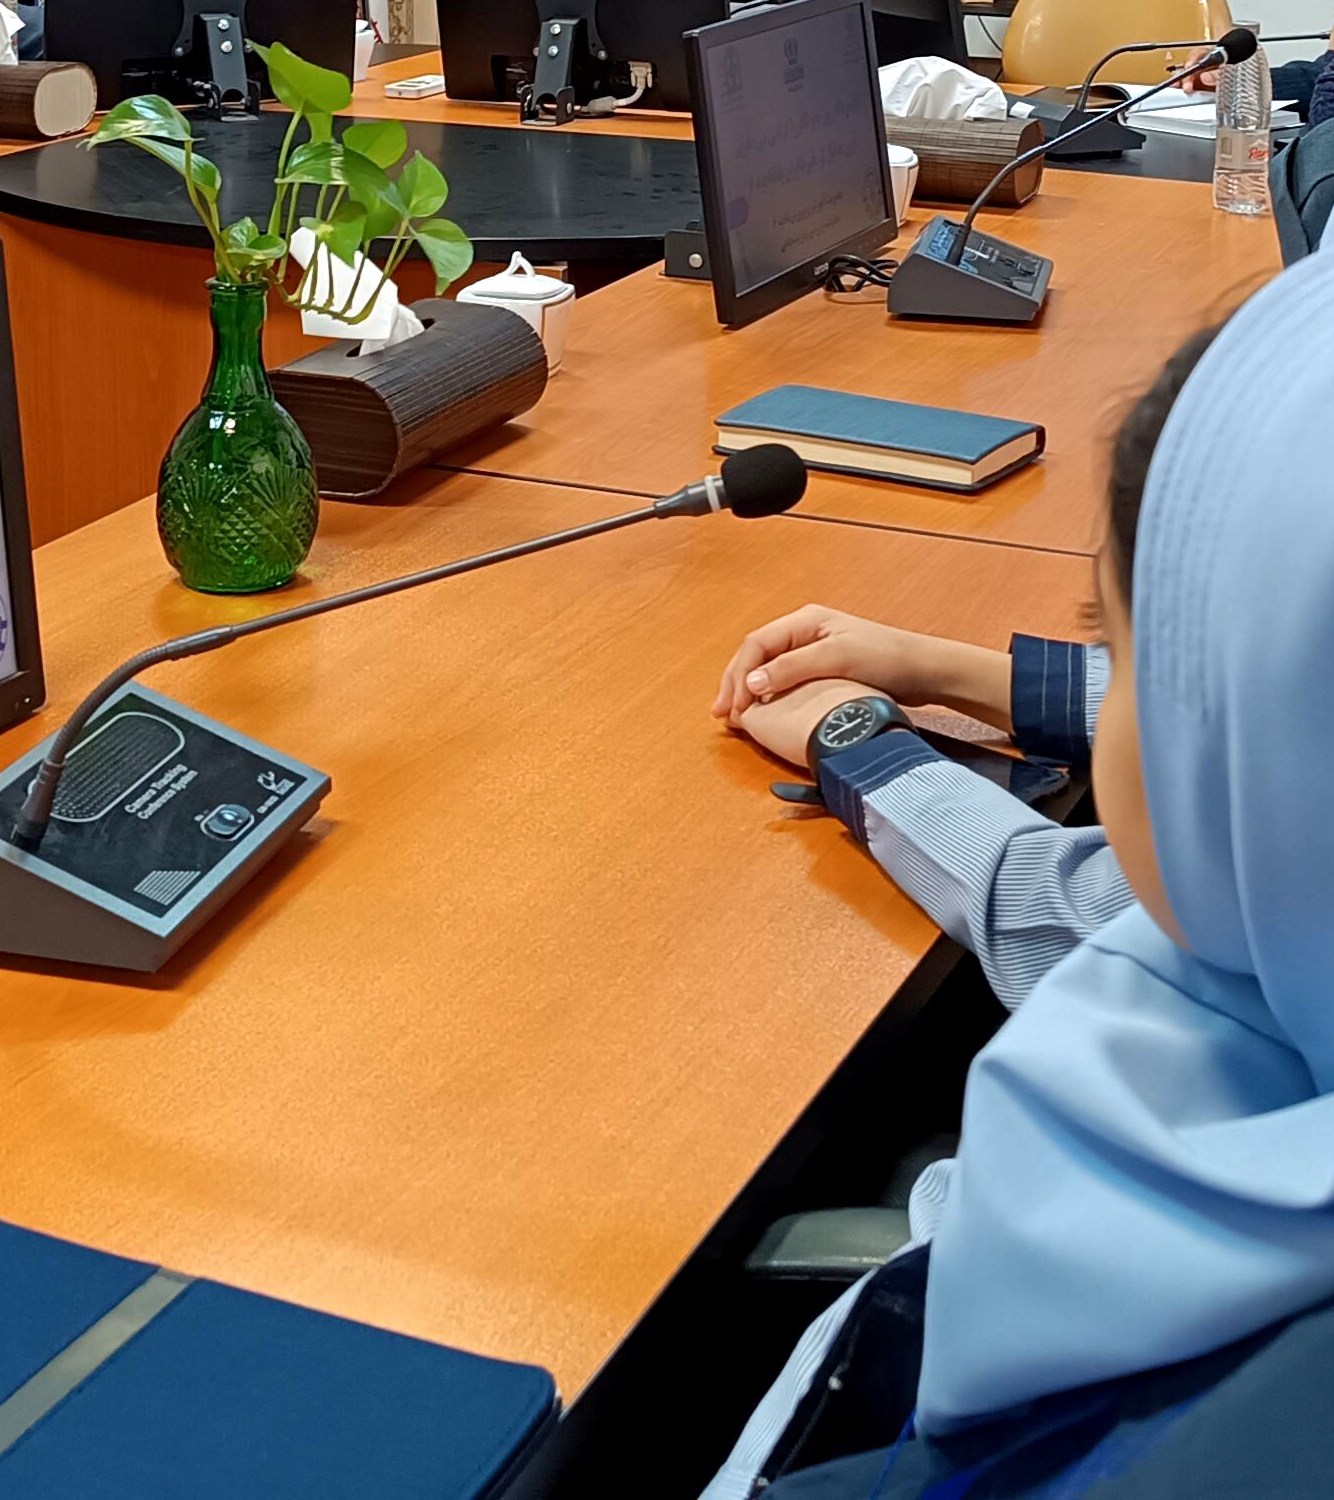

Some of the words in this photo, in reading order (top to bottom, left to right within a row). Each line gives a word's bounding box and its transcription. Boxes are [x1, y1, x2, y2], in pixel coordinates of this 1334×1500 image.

[124, 788, 157, 813] Camera
[150, 764, 188, 790] Tracking
[170, 770, 199, 791] System
